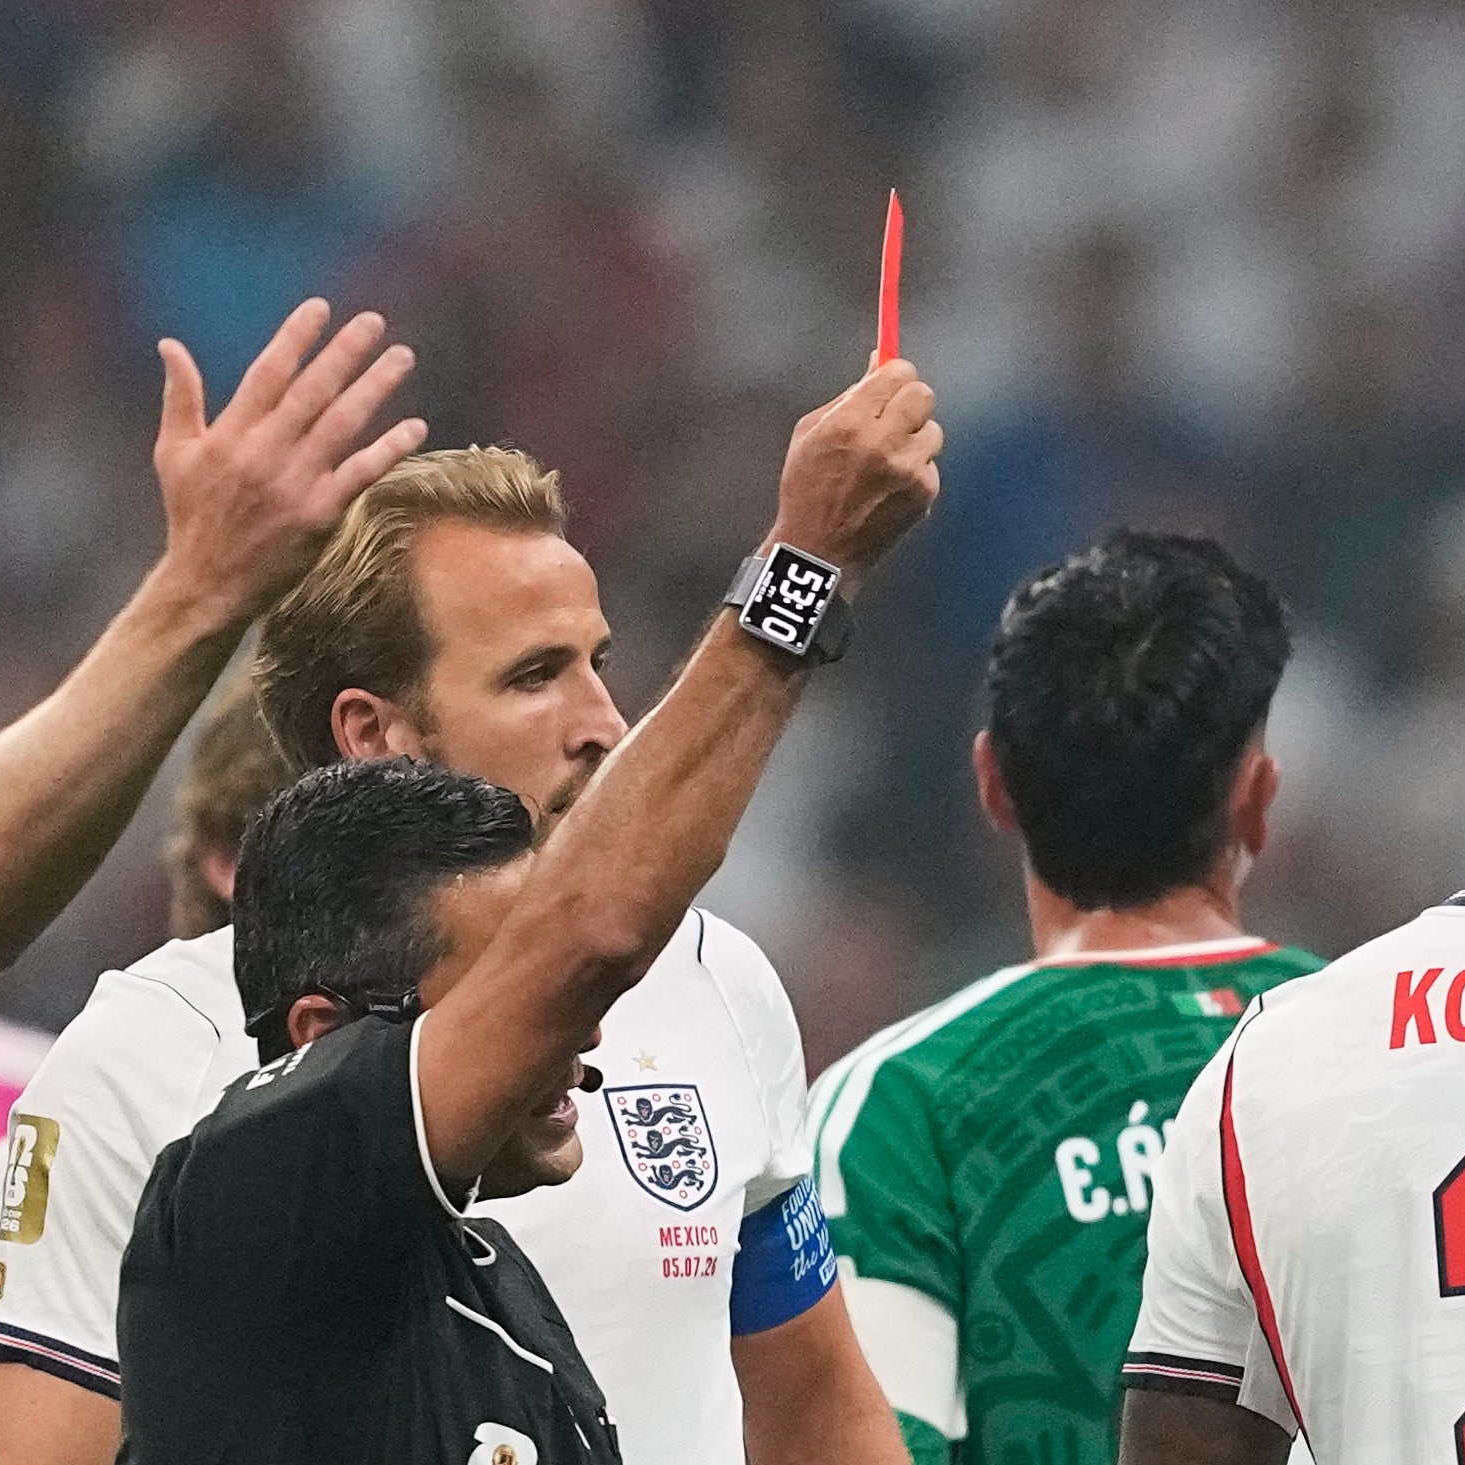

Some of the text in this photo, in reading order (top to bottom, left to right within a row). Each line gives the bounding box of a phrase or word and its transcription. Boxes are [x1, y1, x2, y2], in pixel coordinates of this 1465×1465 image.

[1054, 1099, 1178, 1224] E.Á
[659, 1226, 719, 1248] MEXICO
[662, 1256, 718, 1279] 05.07.26
